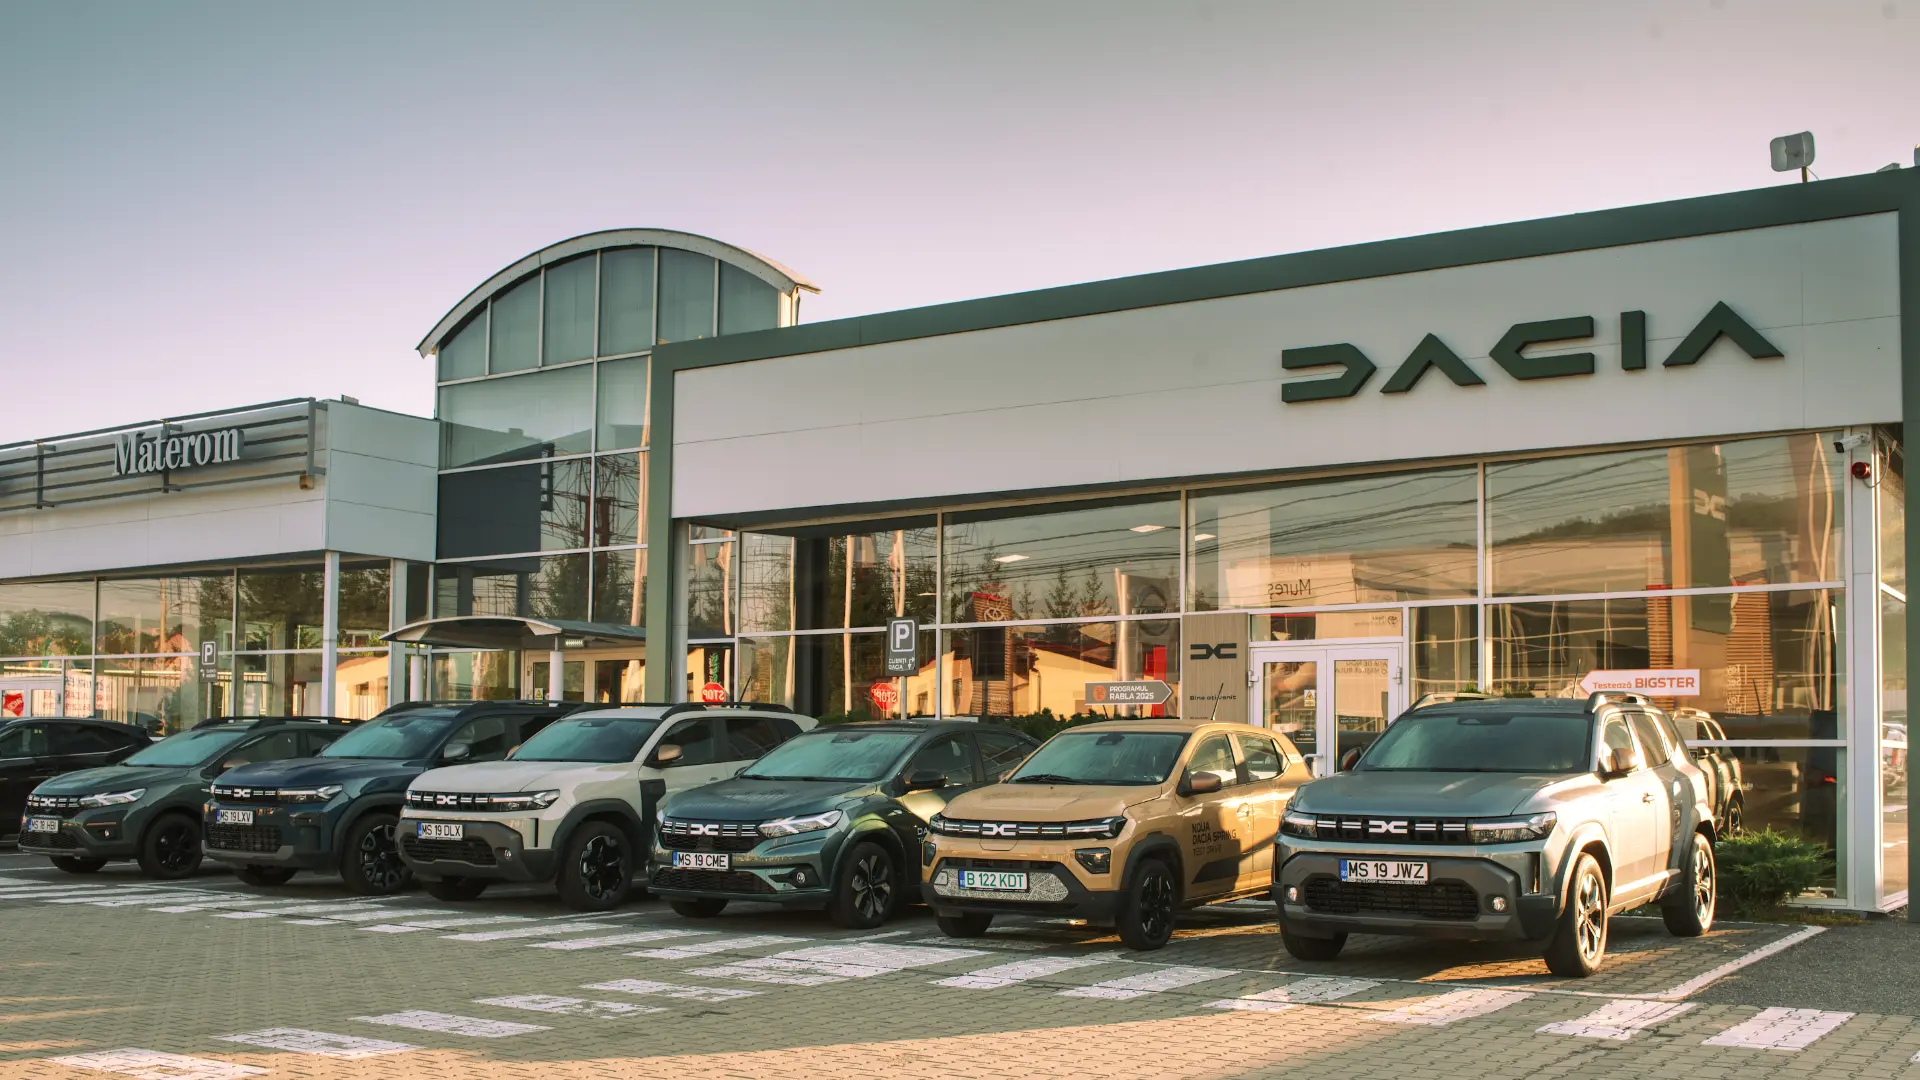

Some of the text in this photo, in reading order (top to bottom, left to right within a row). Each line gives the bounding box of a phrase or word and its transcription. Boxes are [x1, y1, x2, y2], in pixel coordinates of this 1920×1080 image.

[1281, 300, 1785, 403] DACIA
[111, 428, 243, 476] Materom
[895, 623, 911, 649] P
[204, 644, 213, 663] P
[1109, 685, 1149, 693] PROGRAMUL
[1634, 677, 1695, 689] BIGSTER
[1109, 692, 1155, 701] RABLA 2025
[422, 824, 461, 837] MS 19 DLX
[1192, 829, 1237, 845] DACIA SPRING
[679, 853, 727, 868] MS 19 CME
[1348, 861, 1425, 879] MS 19 JWZ
[967, 872, 975, 886] B
[978, 872, 997, 887] 122
[999, 873, 1024, 888] KDT
